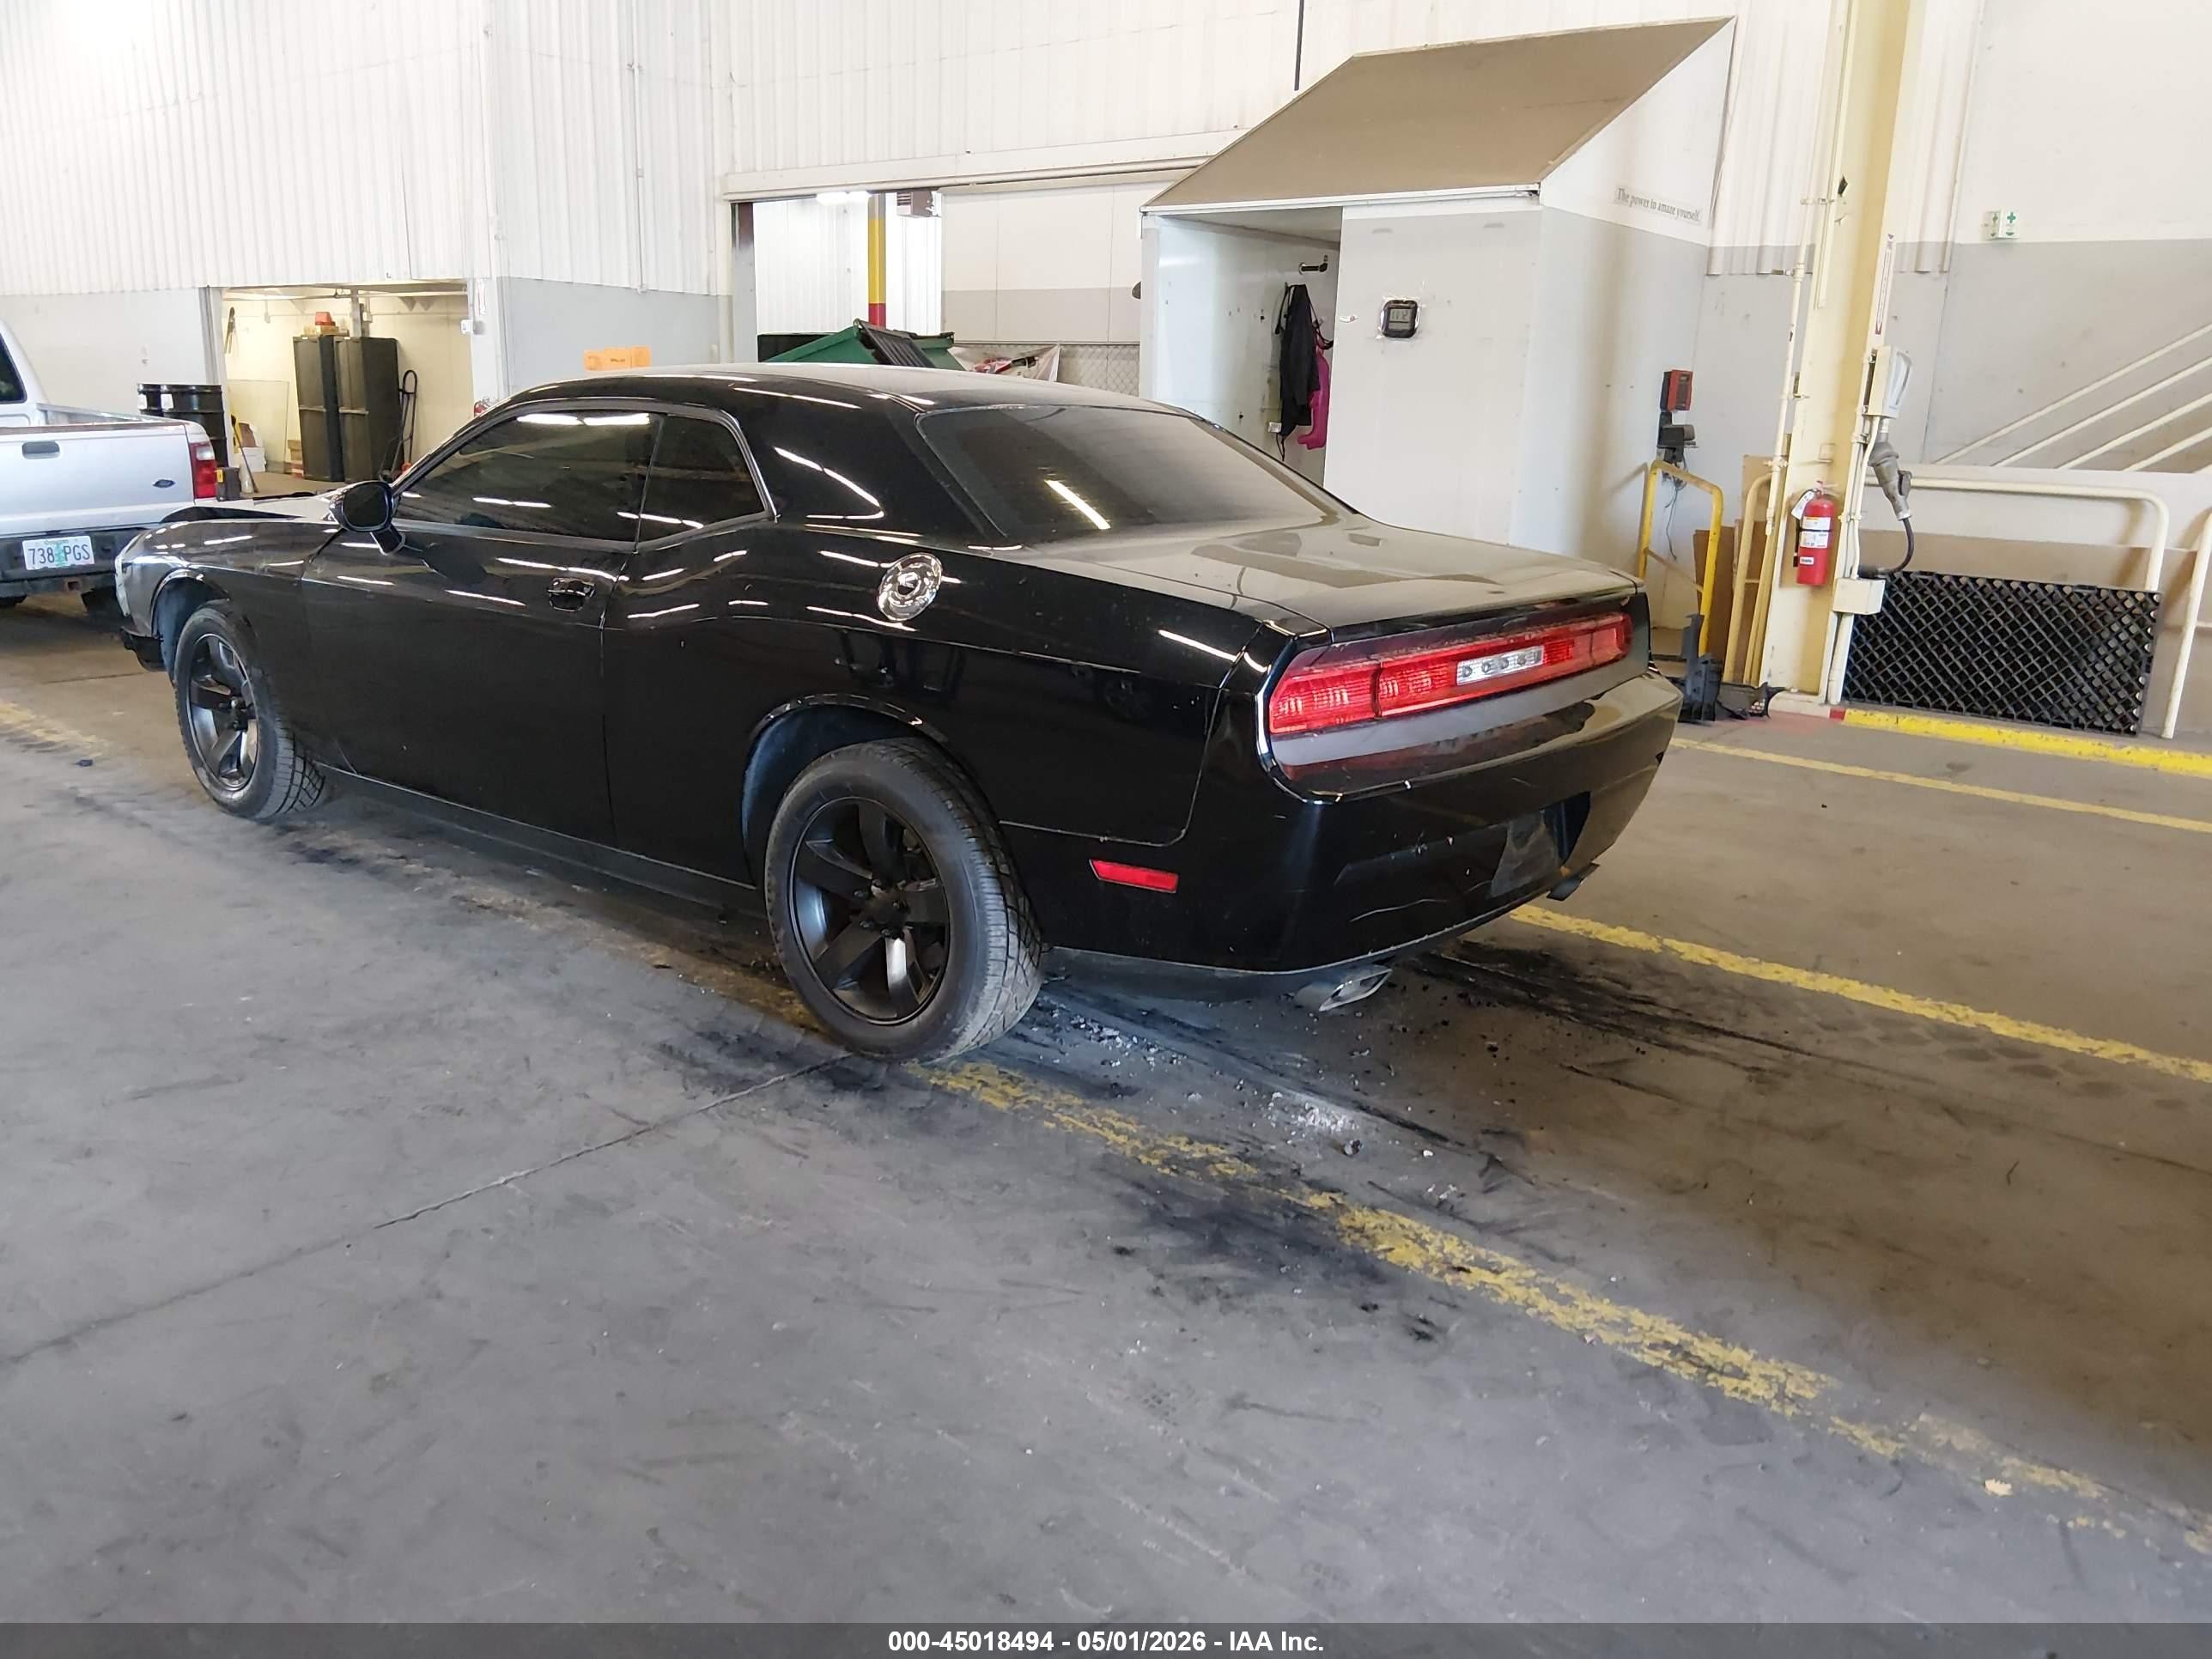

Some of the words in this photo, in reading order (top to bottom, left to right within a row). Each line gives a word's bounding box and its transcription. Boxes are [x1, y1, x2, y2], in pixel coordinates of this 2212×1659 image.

[1617, 187, 1630, 203] The
[1629, 195, 1650, 208] power
[27, 547, 55, 565] 738
[63, 544, 90, 562] PGS
